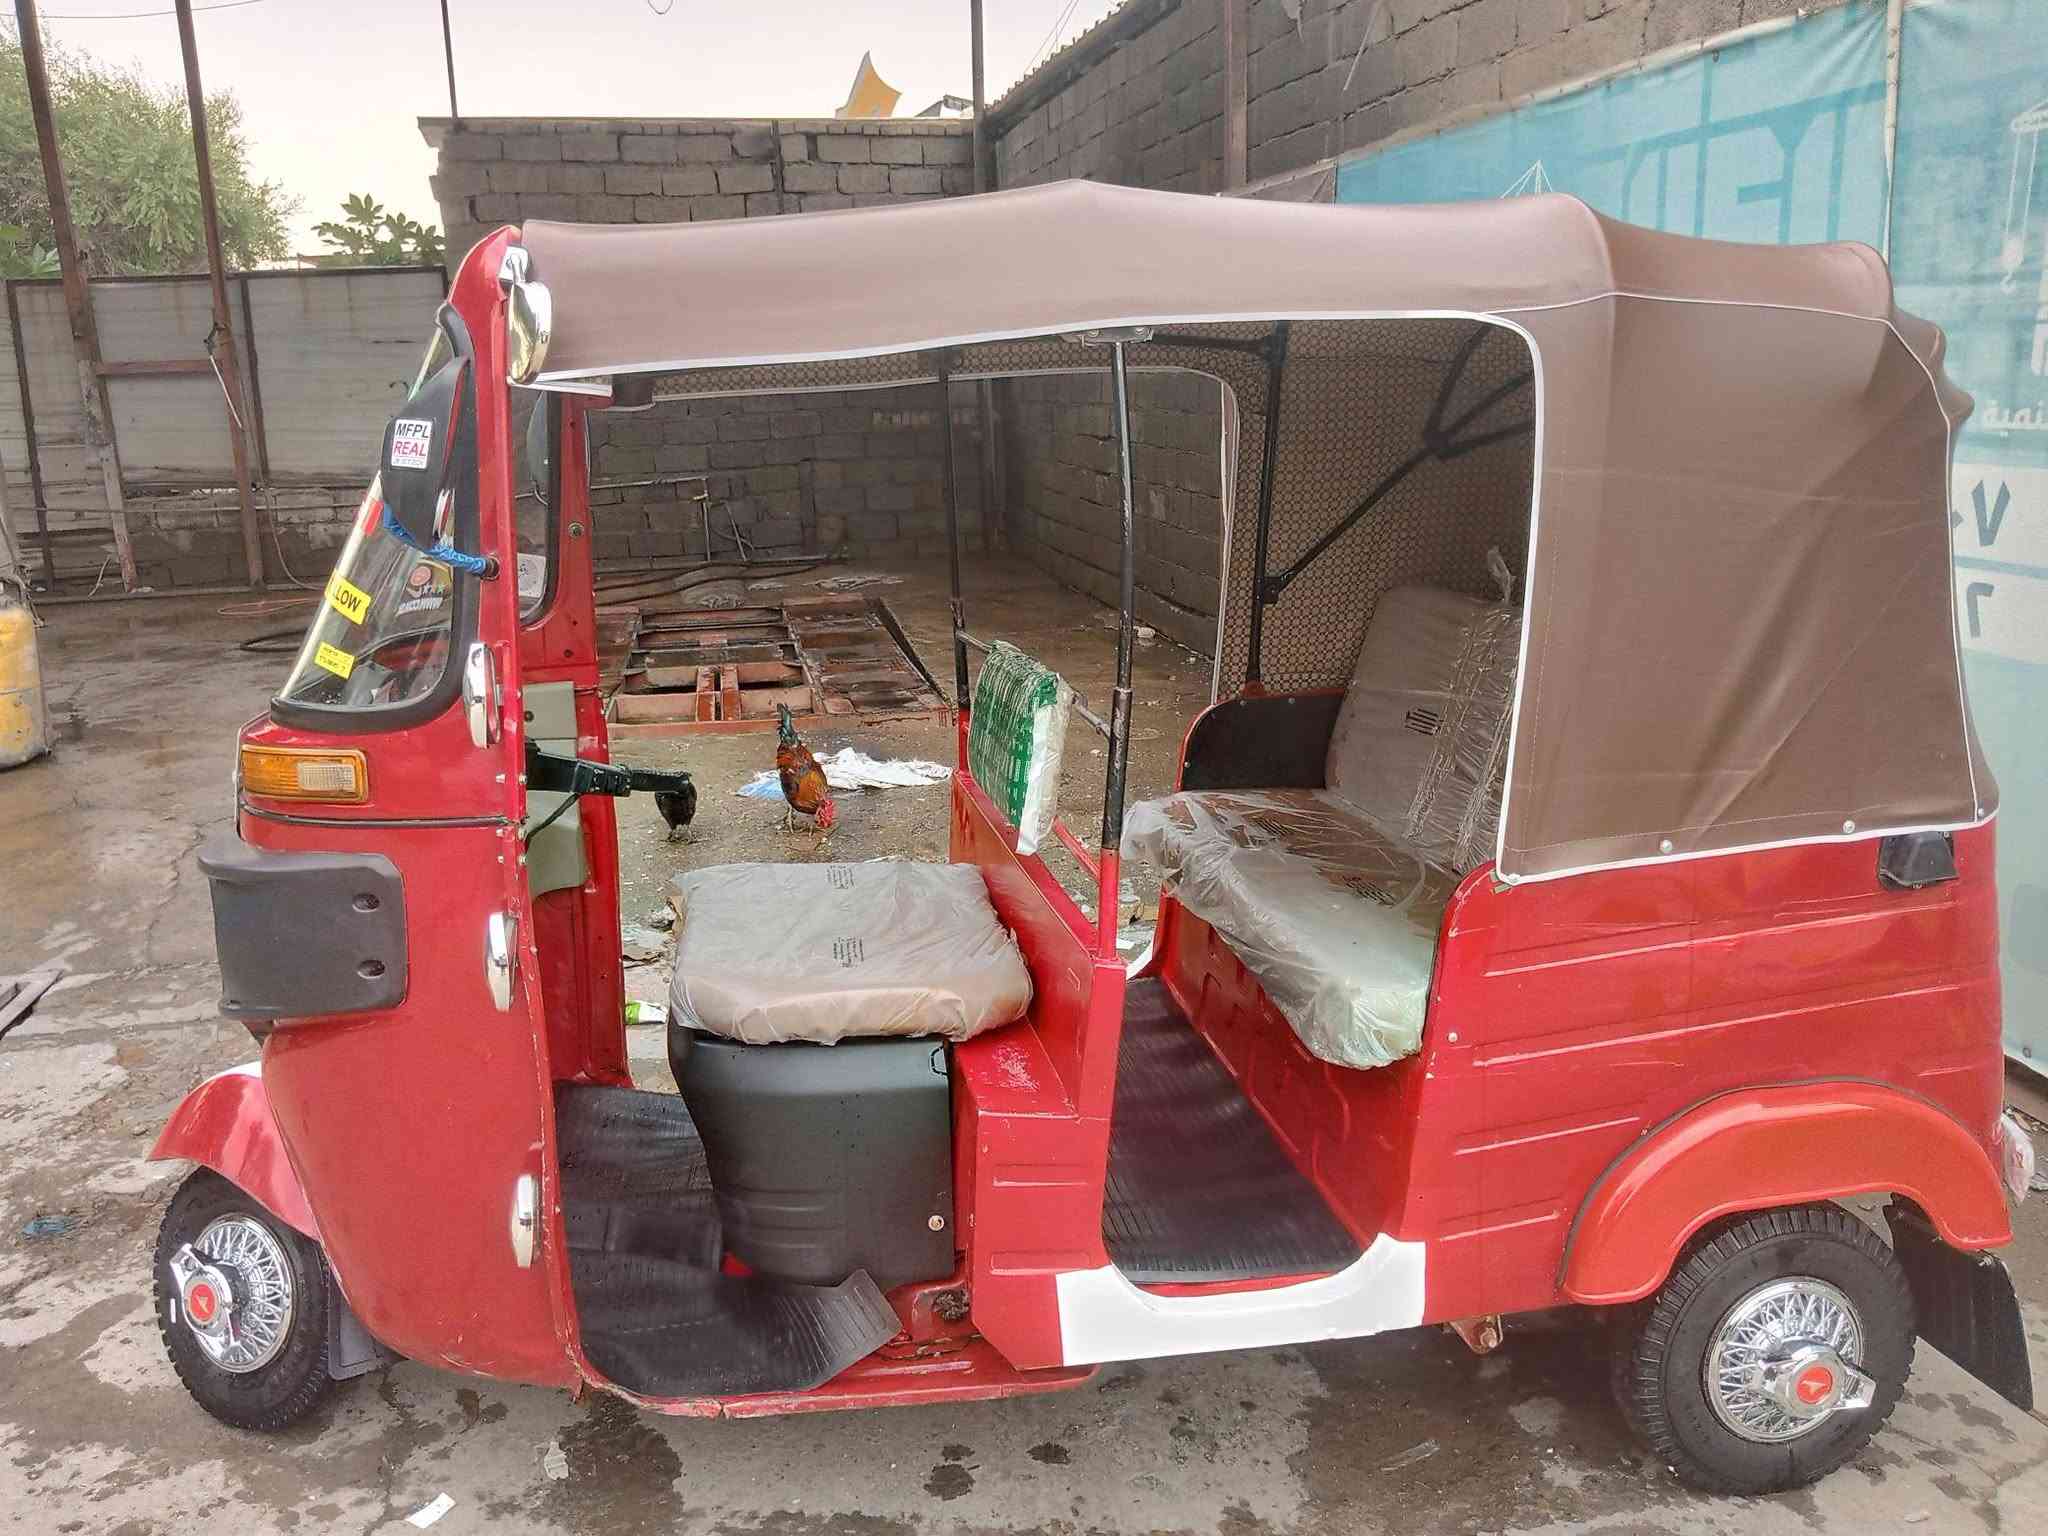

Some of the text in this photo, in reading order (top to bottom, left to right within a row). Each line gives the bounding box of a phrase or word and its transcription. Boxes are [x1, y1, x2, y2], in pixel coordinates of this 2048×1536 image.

[395, 423, 429, 439] MFPL
[393, 440, 427, 457] REAL
[335, 585, 362, 613] LOW
